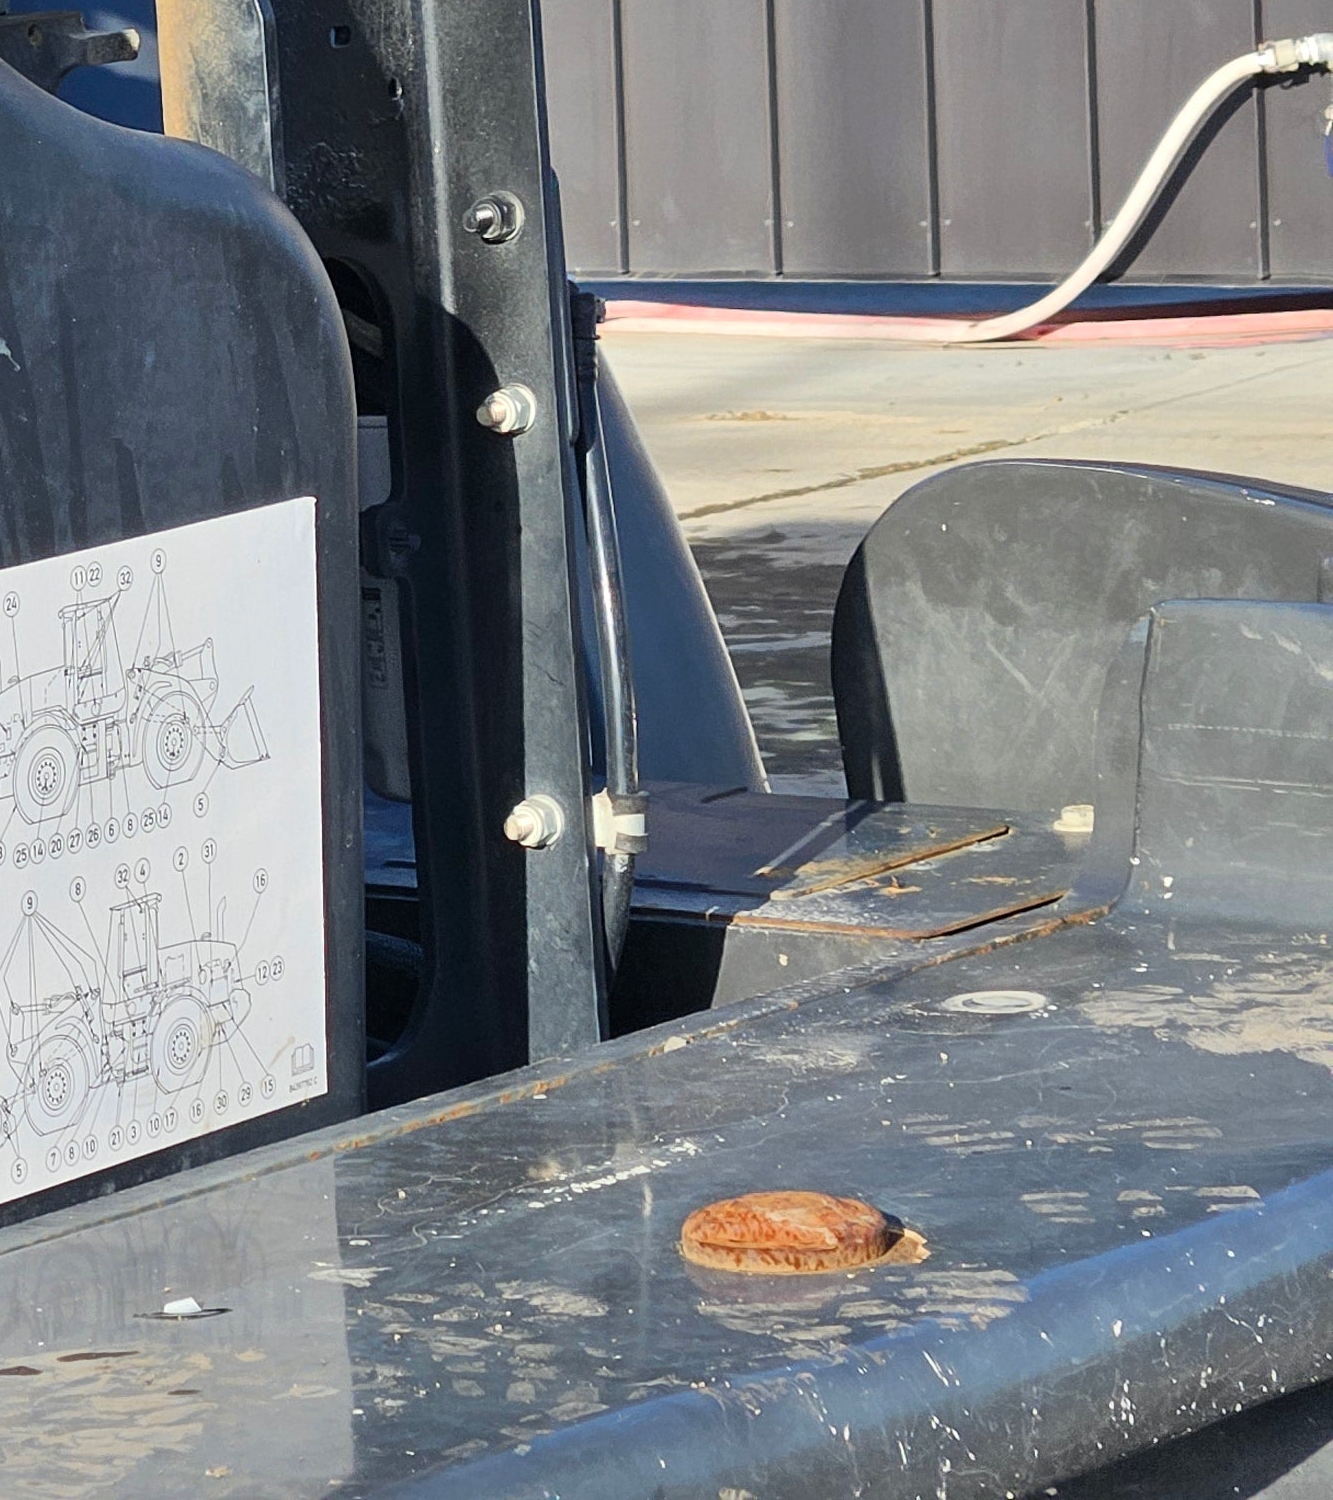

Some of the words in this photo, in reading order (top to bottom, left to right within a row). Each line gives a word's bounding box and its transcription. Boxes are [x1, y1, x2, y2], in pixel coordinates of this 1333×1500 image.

[74, 570, 84, 586] 11
[89, 566, 101, 583] 22
[119, 570, 132, 586] 32
[5, 596, 18, 612] 24
[143, 811, 155, 828] 25
[158, 808, 169, 823] 14
[69, 832, 81, 849] 27
[87, 827, 100, 844] 26
[32, 843, 44, 858] 14
[50, 837, 63, 854] 20
[204, 843, 214, 859] 31
[15, 847, 28, 864] 25
[117, 868, 129, 885] 32
[255, 873, 266, 888] 16
[257, 965, 268, 980] 12
[272, 960, 283, 976] 23
[263, 1078, 274, 1093] 15
[216, 1094, 227, 1110] 30
[240, 1086, 251, 1102] 29
[191, 1102, 202, 1118] 16
[149, 1117, 160, 1132] 10
[164, 1111, 175, 1127] 17
[85, 1138, 96, 1154] 10
[111, 1130, 121, 1146] 21
